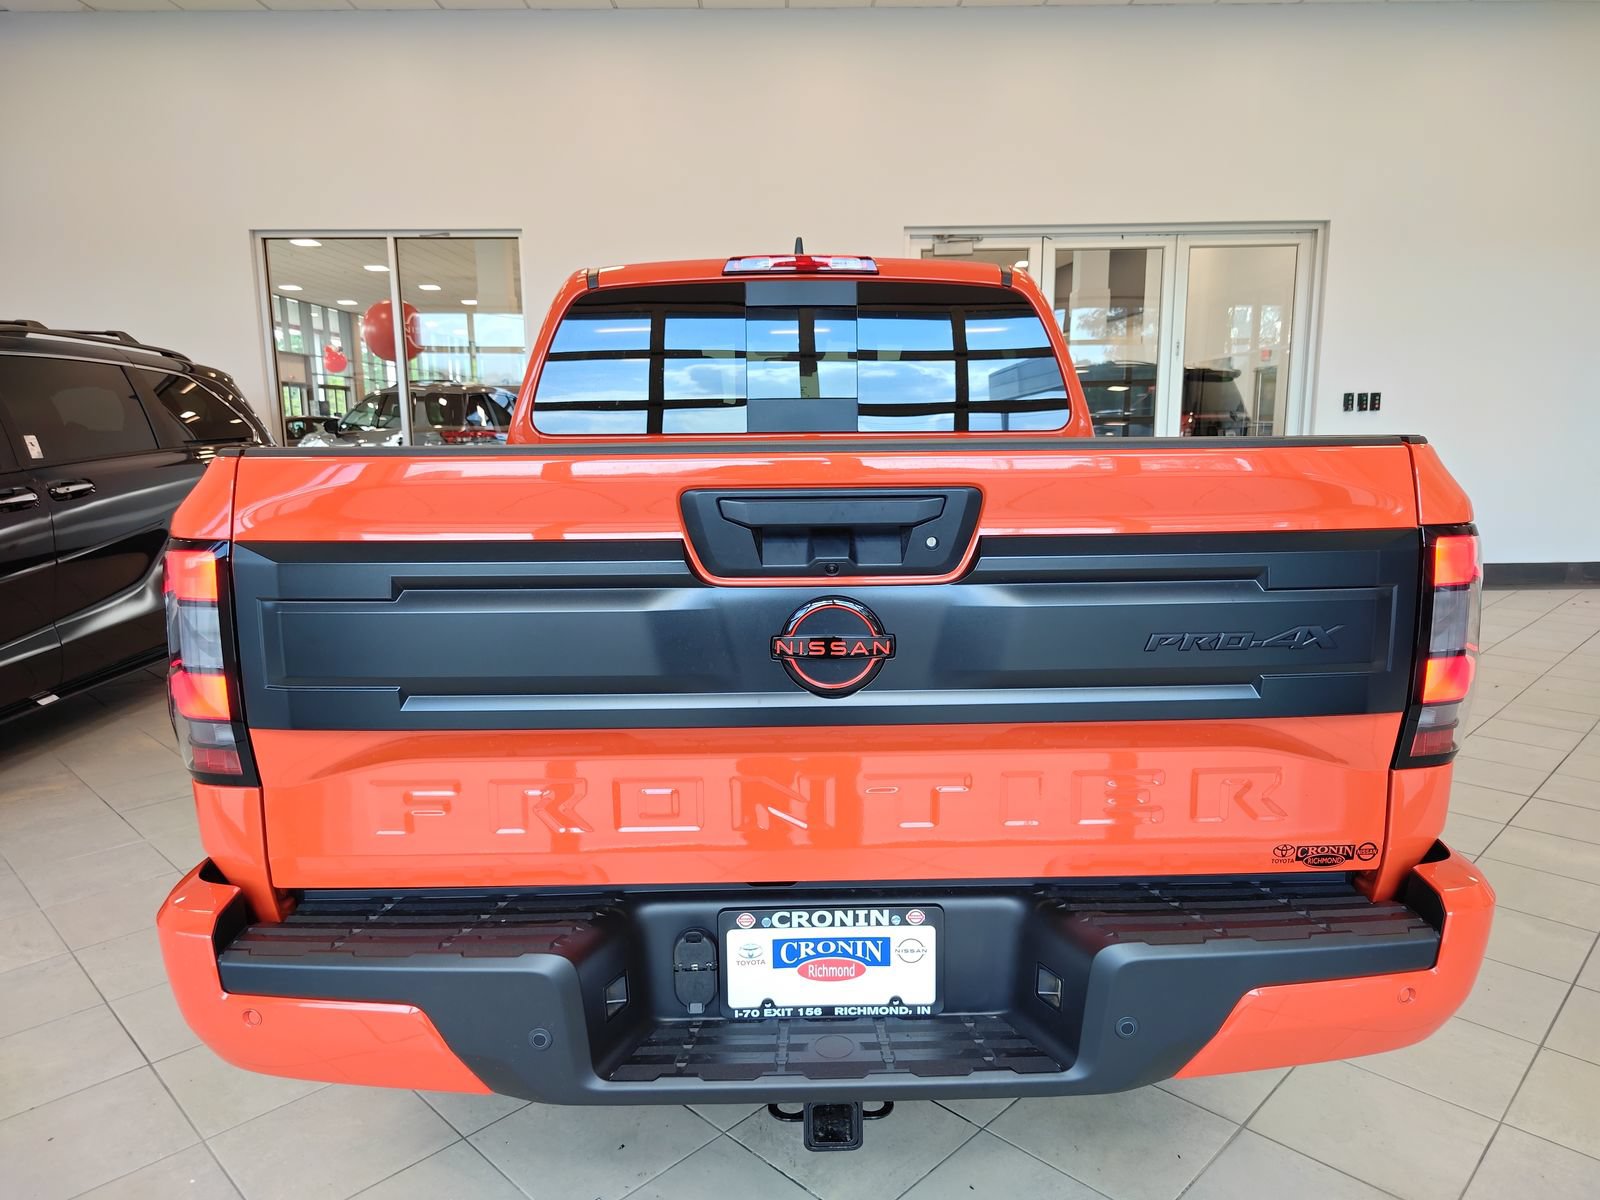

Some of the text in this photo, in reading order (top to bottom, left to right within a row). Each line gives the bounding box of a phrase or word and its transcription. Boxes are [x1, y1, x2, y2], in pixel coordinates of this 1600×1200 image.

[775, 640, 891, 656] NISSAN
[373, 764, 1291, 836] FRONTIER
[1297, 845, 1354, 858] CRONIN
[1356, 848, 1378, 856] NISSAN
[1307, 857, 1342, 865] RICHMOND
[772, 909, 890, 928] CRONIN
[780, 939, 883, 964] CRONIN
[808, 963, 856, 978] Richmond
[734, 1007, 823, 1018] I-70 EXIT 156
[834, 1005, 931, 1016] RICHMOND, IN
